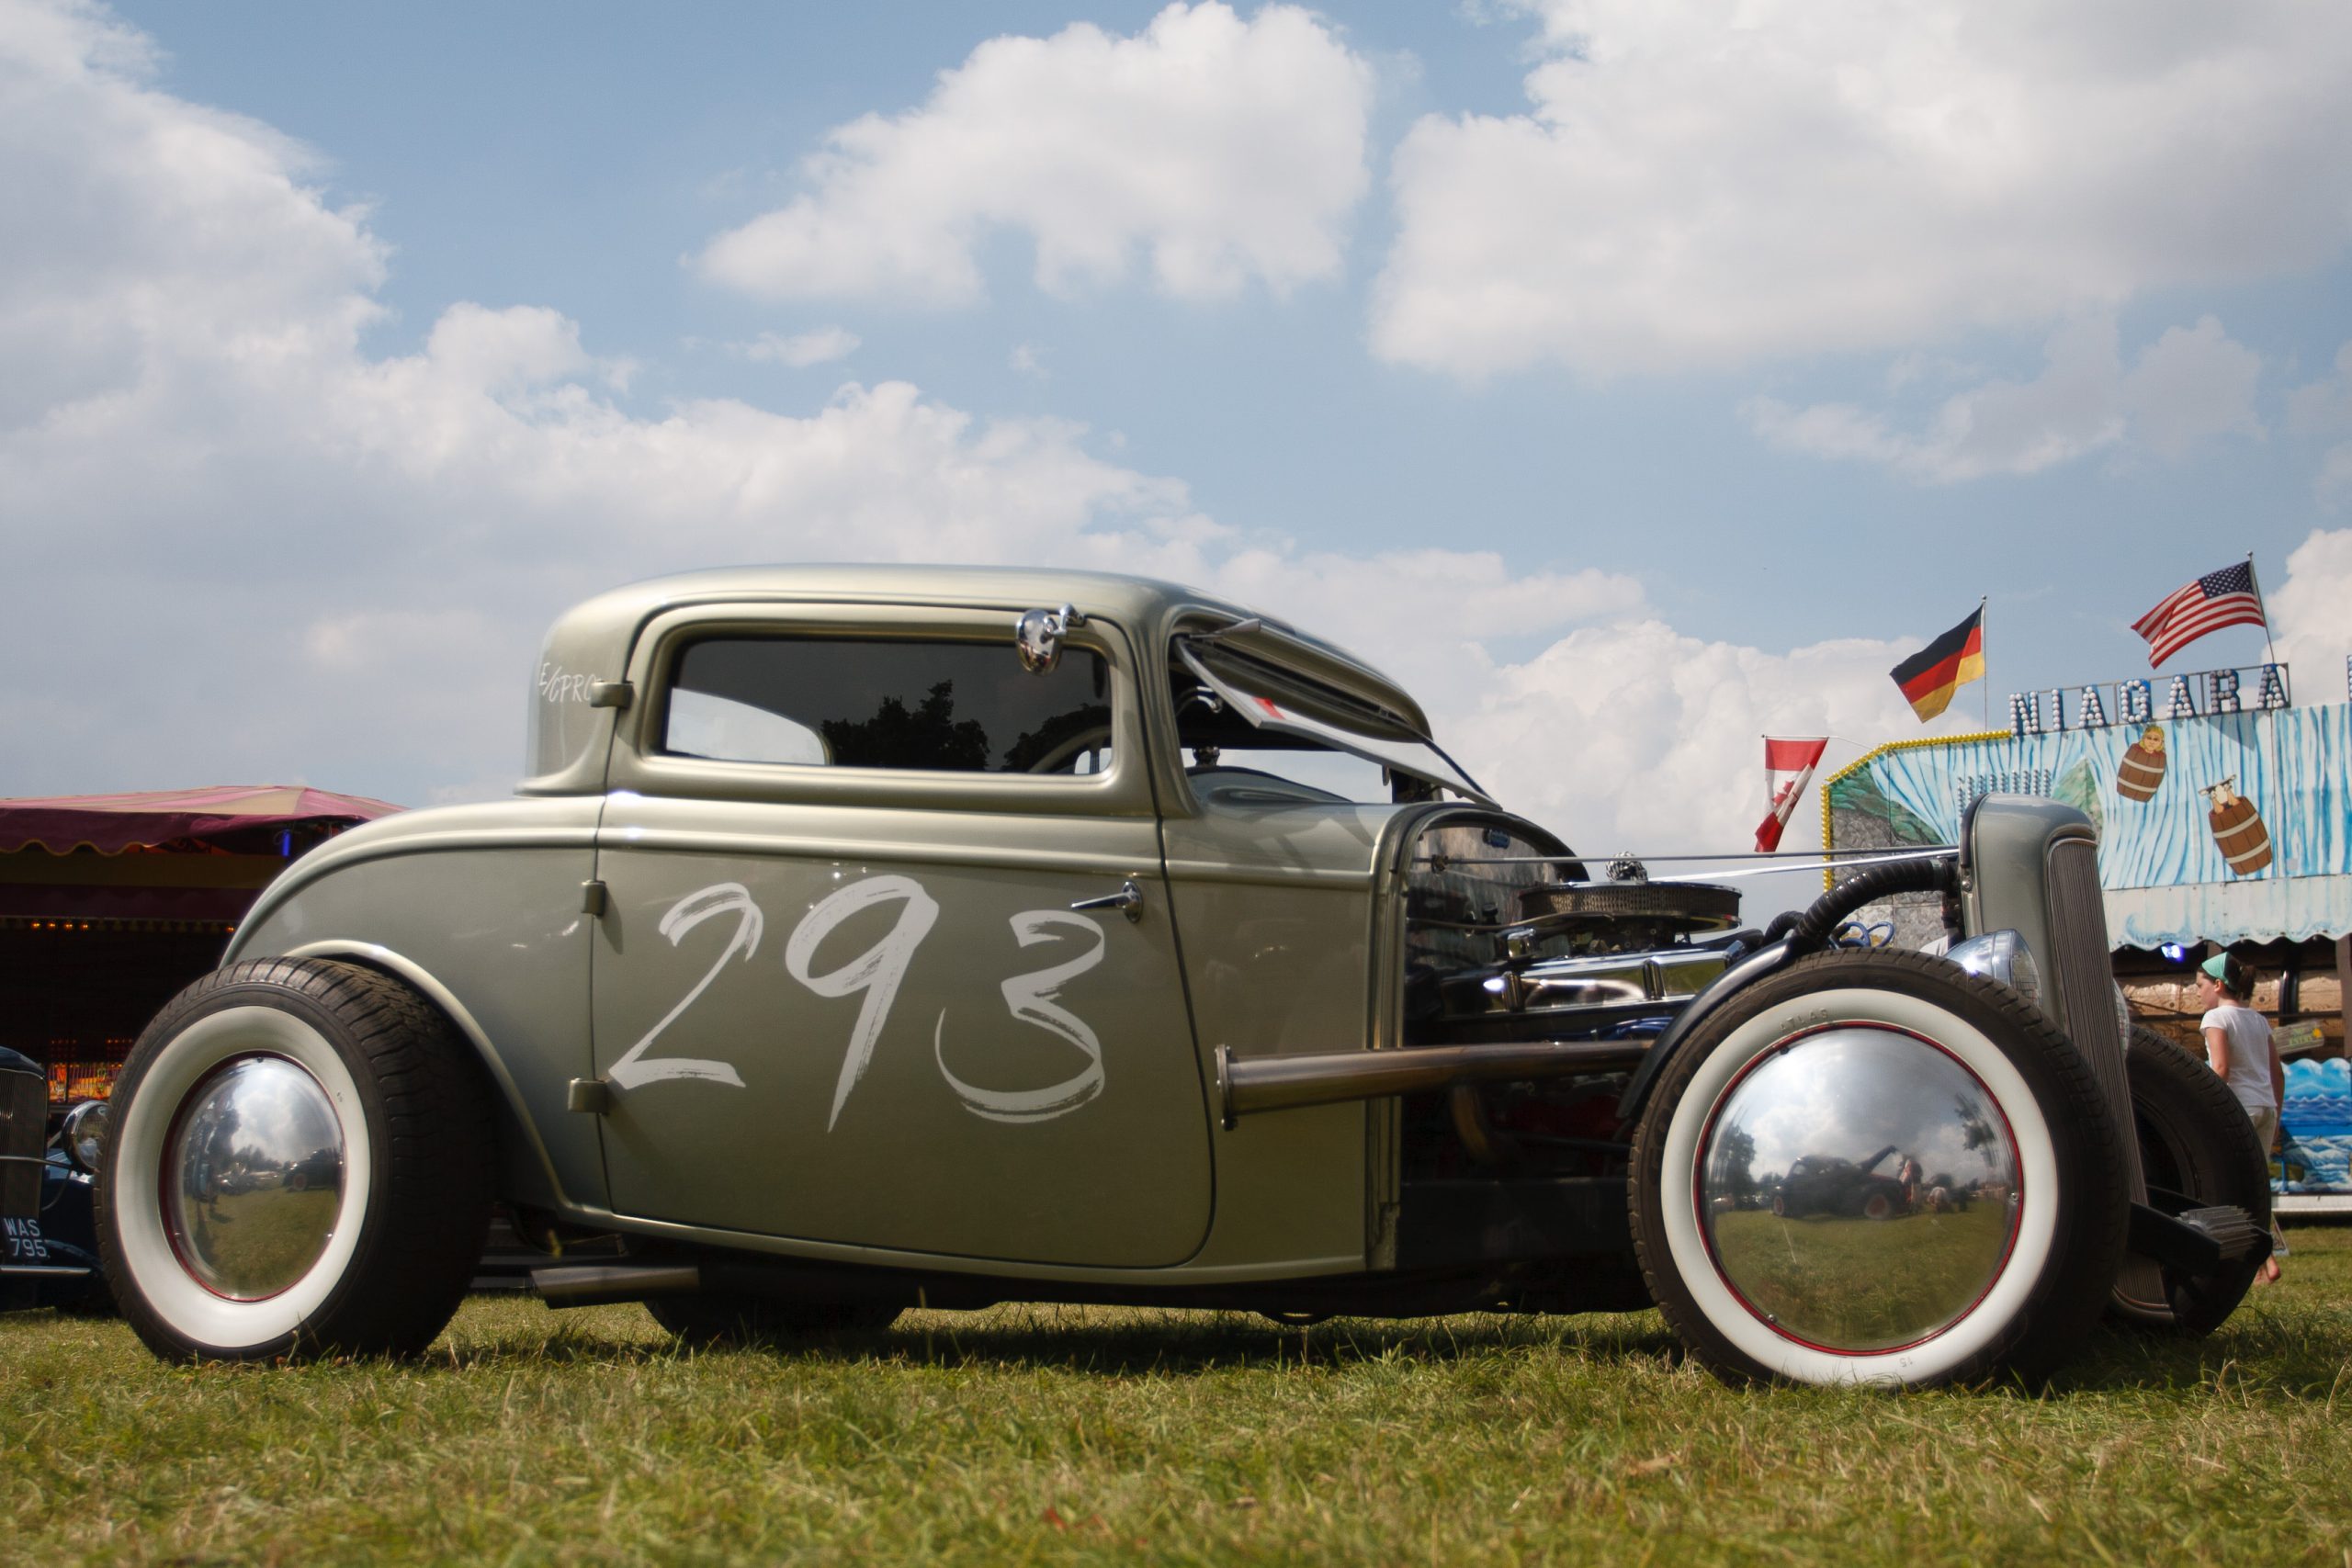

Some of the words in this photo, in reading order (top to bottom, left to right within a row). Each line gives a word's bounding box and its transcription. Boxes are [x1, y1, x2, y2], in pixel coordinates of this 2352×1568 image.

[2008, 663, 2290, 735] NIAGARA
[608, 874, 1105, 1133] 293
[3, 1217, 40, 1237] WAS
[9, 1237, 47, 1258] 795
